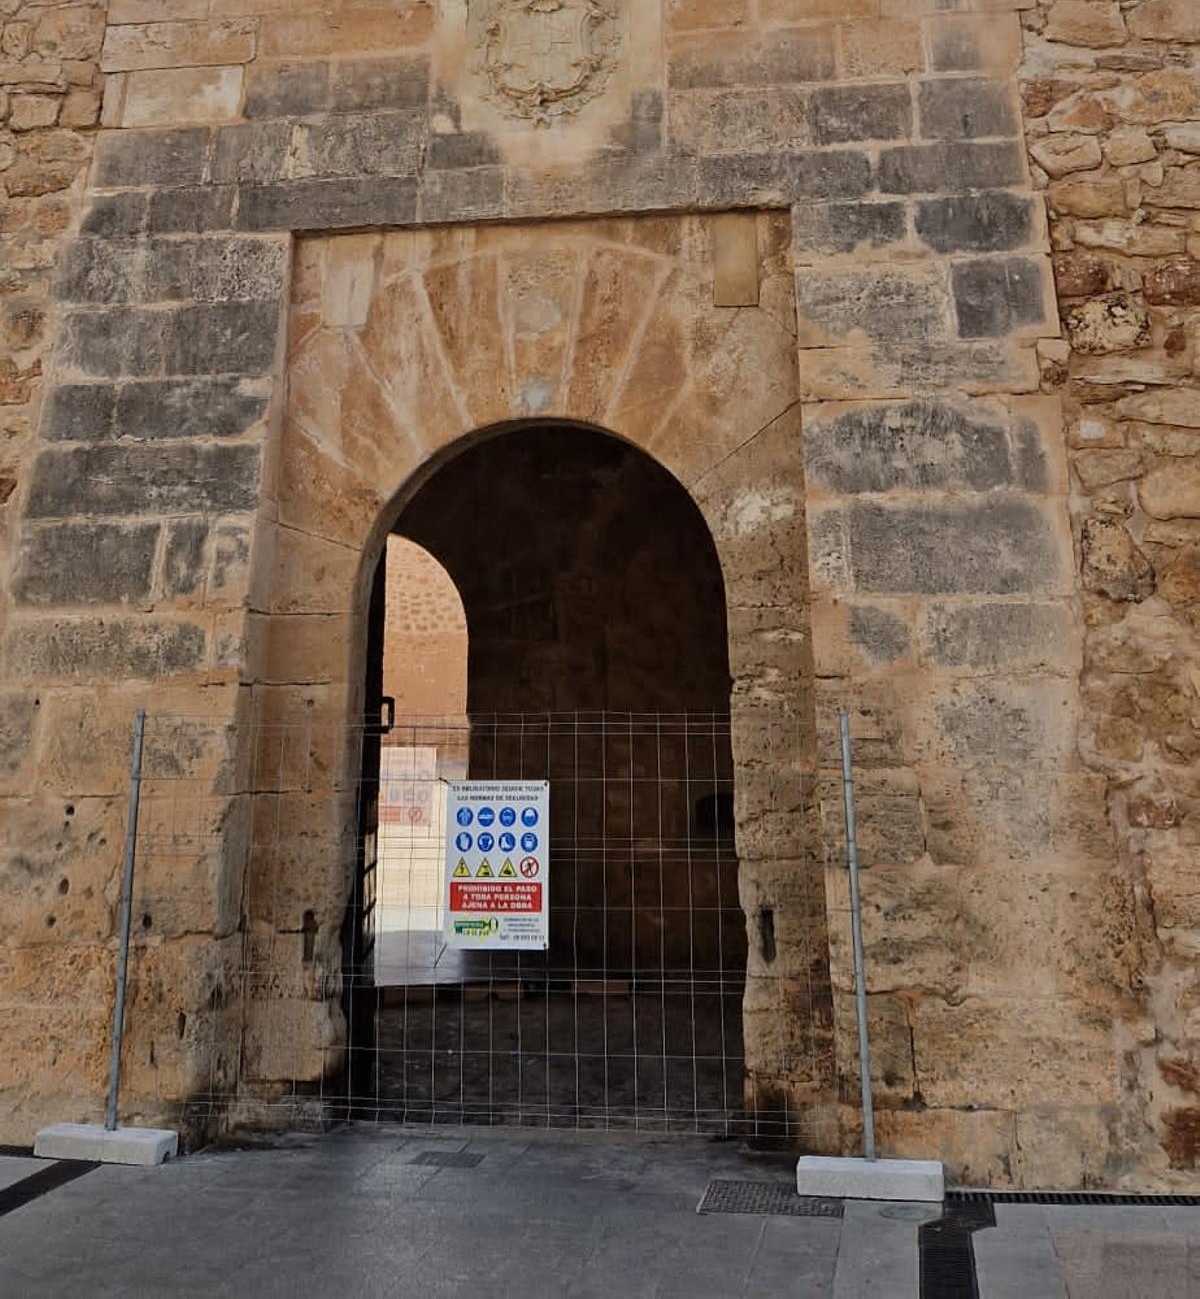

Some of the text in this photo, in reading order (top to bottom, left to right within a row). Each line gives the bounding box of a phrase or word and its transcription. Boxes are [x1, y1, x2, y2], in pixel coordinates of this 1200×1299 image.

[458, 885, 537, 893] PROHIBIDO EL PASO
[471, 893, 492, 901] TODA
[494, 893, 532, 901] PERSONA
[462, 901, 488, 909] AJENA
[498, 901, 508, 909] LA
[510, 901, 533, 909] OBRA
